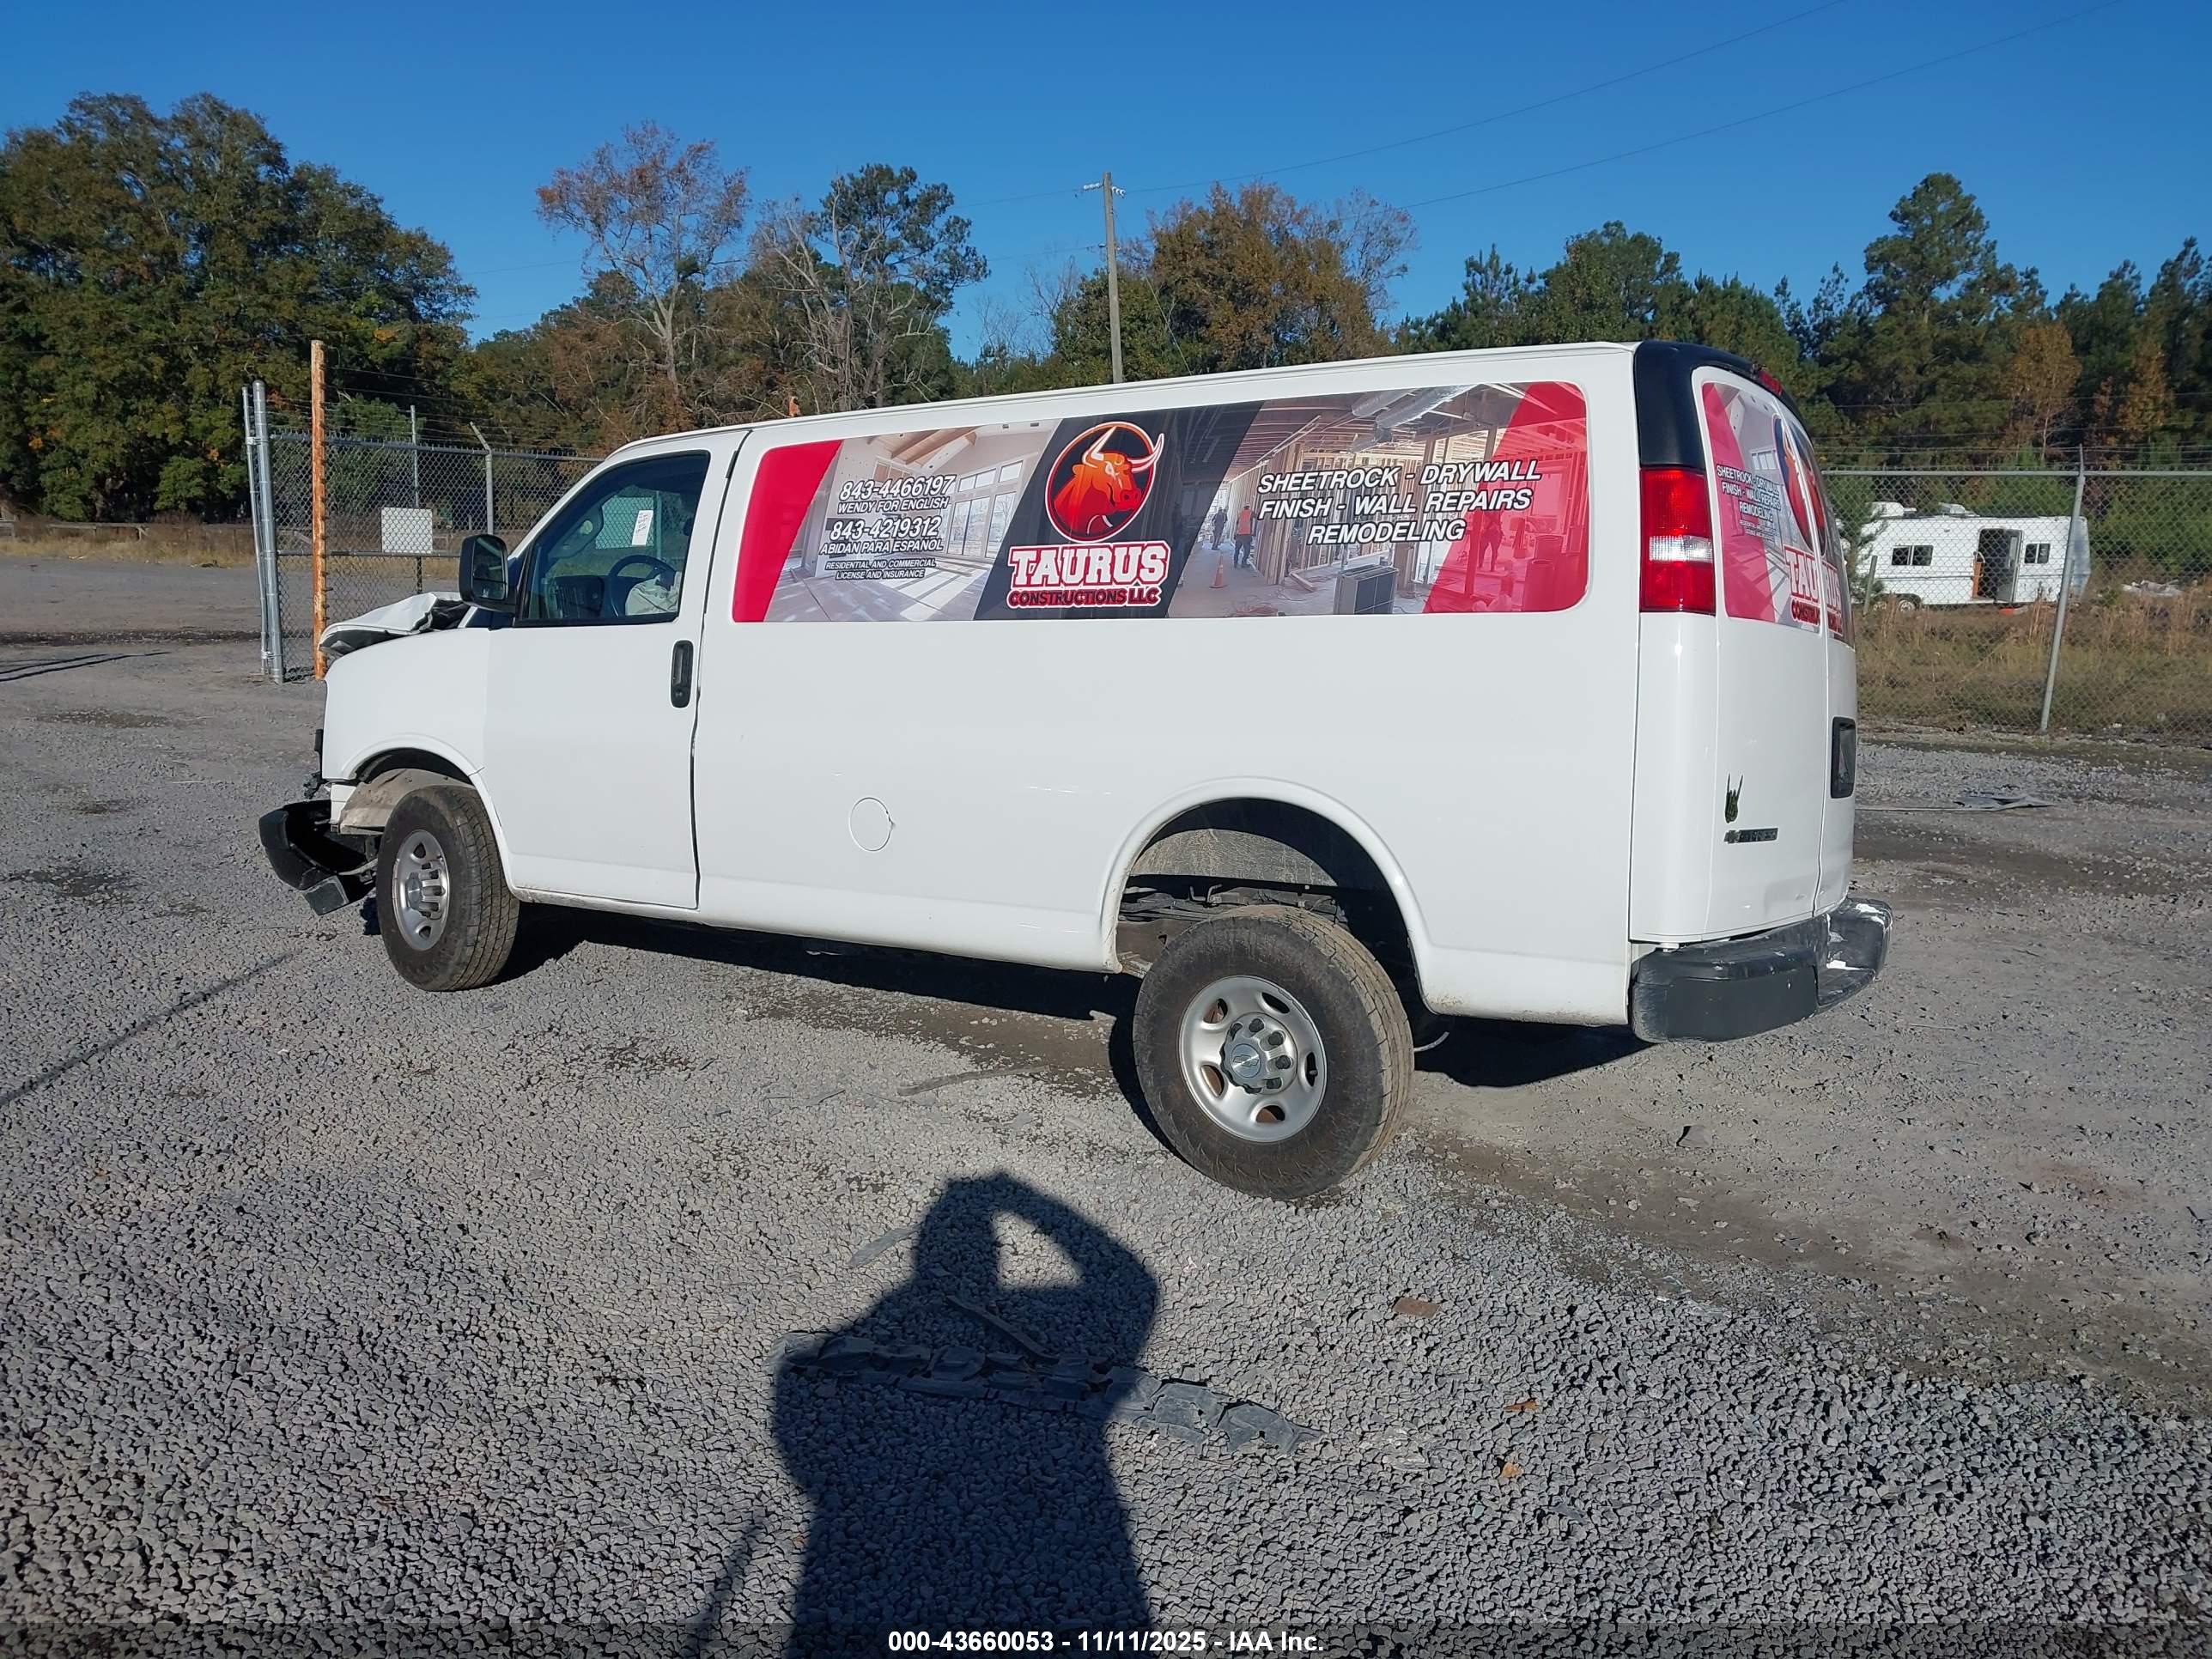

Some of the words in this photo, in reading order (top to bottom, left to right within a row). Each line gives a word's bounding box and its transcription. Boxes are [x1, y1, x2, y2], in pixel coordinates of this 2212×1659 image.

[839, 475, 956, 501] 843-4466197
[1257, 466, 1400, 493] SHEETROCK
[1419, 460, 1542, 485] DRYWALL
[838, 501, 876, 514] WENDY
[878, 500, 899, 512] FOR
[901, 497, 950, 510] ENGLISH
[1258, 498, 1333, 520] FINISH
[1354, 494, 1416, 515] WALL
[1425, 489, 1533, 513] REPAIRS
[830, 516, 942, 540] 843-4219312
[1307, 520, 1467, 544] REMODELING
[819, 543, 860, 555] ABIDAN
[861, 542, 890, 553] PARA
[825, 561, 870, 569] RESIDENTIAL
[871, 560, 887, 568] AND
[888, 559, 936, 568] COMMERCIAL
[836, 571, 866, 580] LICENSE
[866, 570, 882, 579] AND
[883, 568, 925, 578] INSURANCE
[1008, 541, 1170, 589] TAURUS
[1008, 588, 1127, 607] CONSTRUCTIONS
[1127, 586, 1160, 605] LLC
